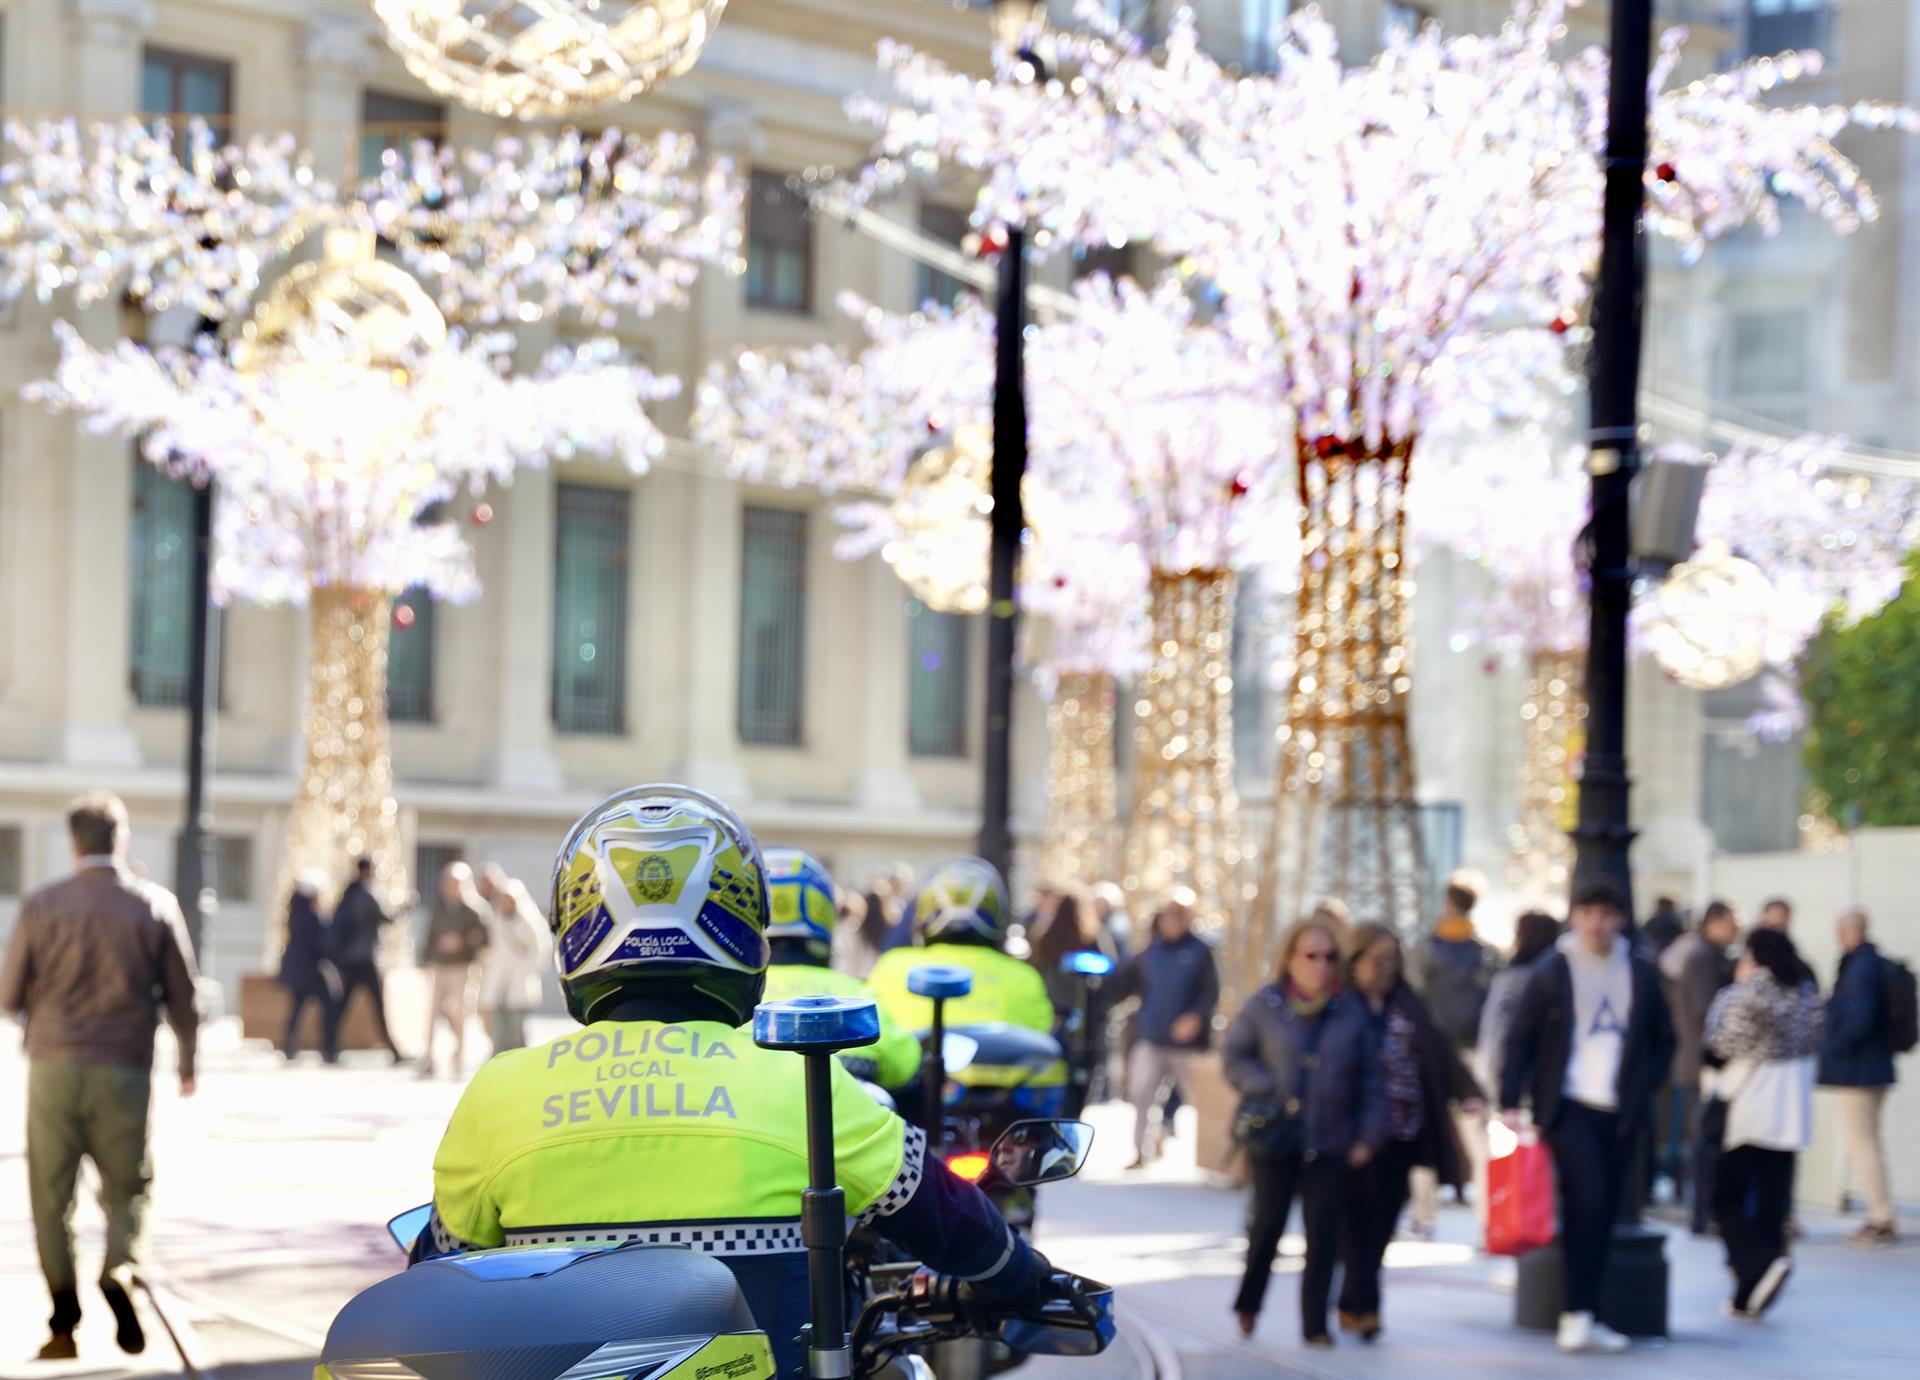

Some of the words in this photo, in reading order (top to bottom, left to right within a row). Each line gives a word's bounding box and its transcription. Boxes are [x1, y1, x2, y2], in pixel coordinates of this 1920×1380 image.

[640, 946, 675, 956] SEVILLA
[661, 935, 690, 947] LOCAL
[547, 1025, 738, 1069] POLICIA
[595, 1060, 678, 1082] LOCAL
[542, 1083, 738, 1128] SEVILLA
